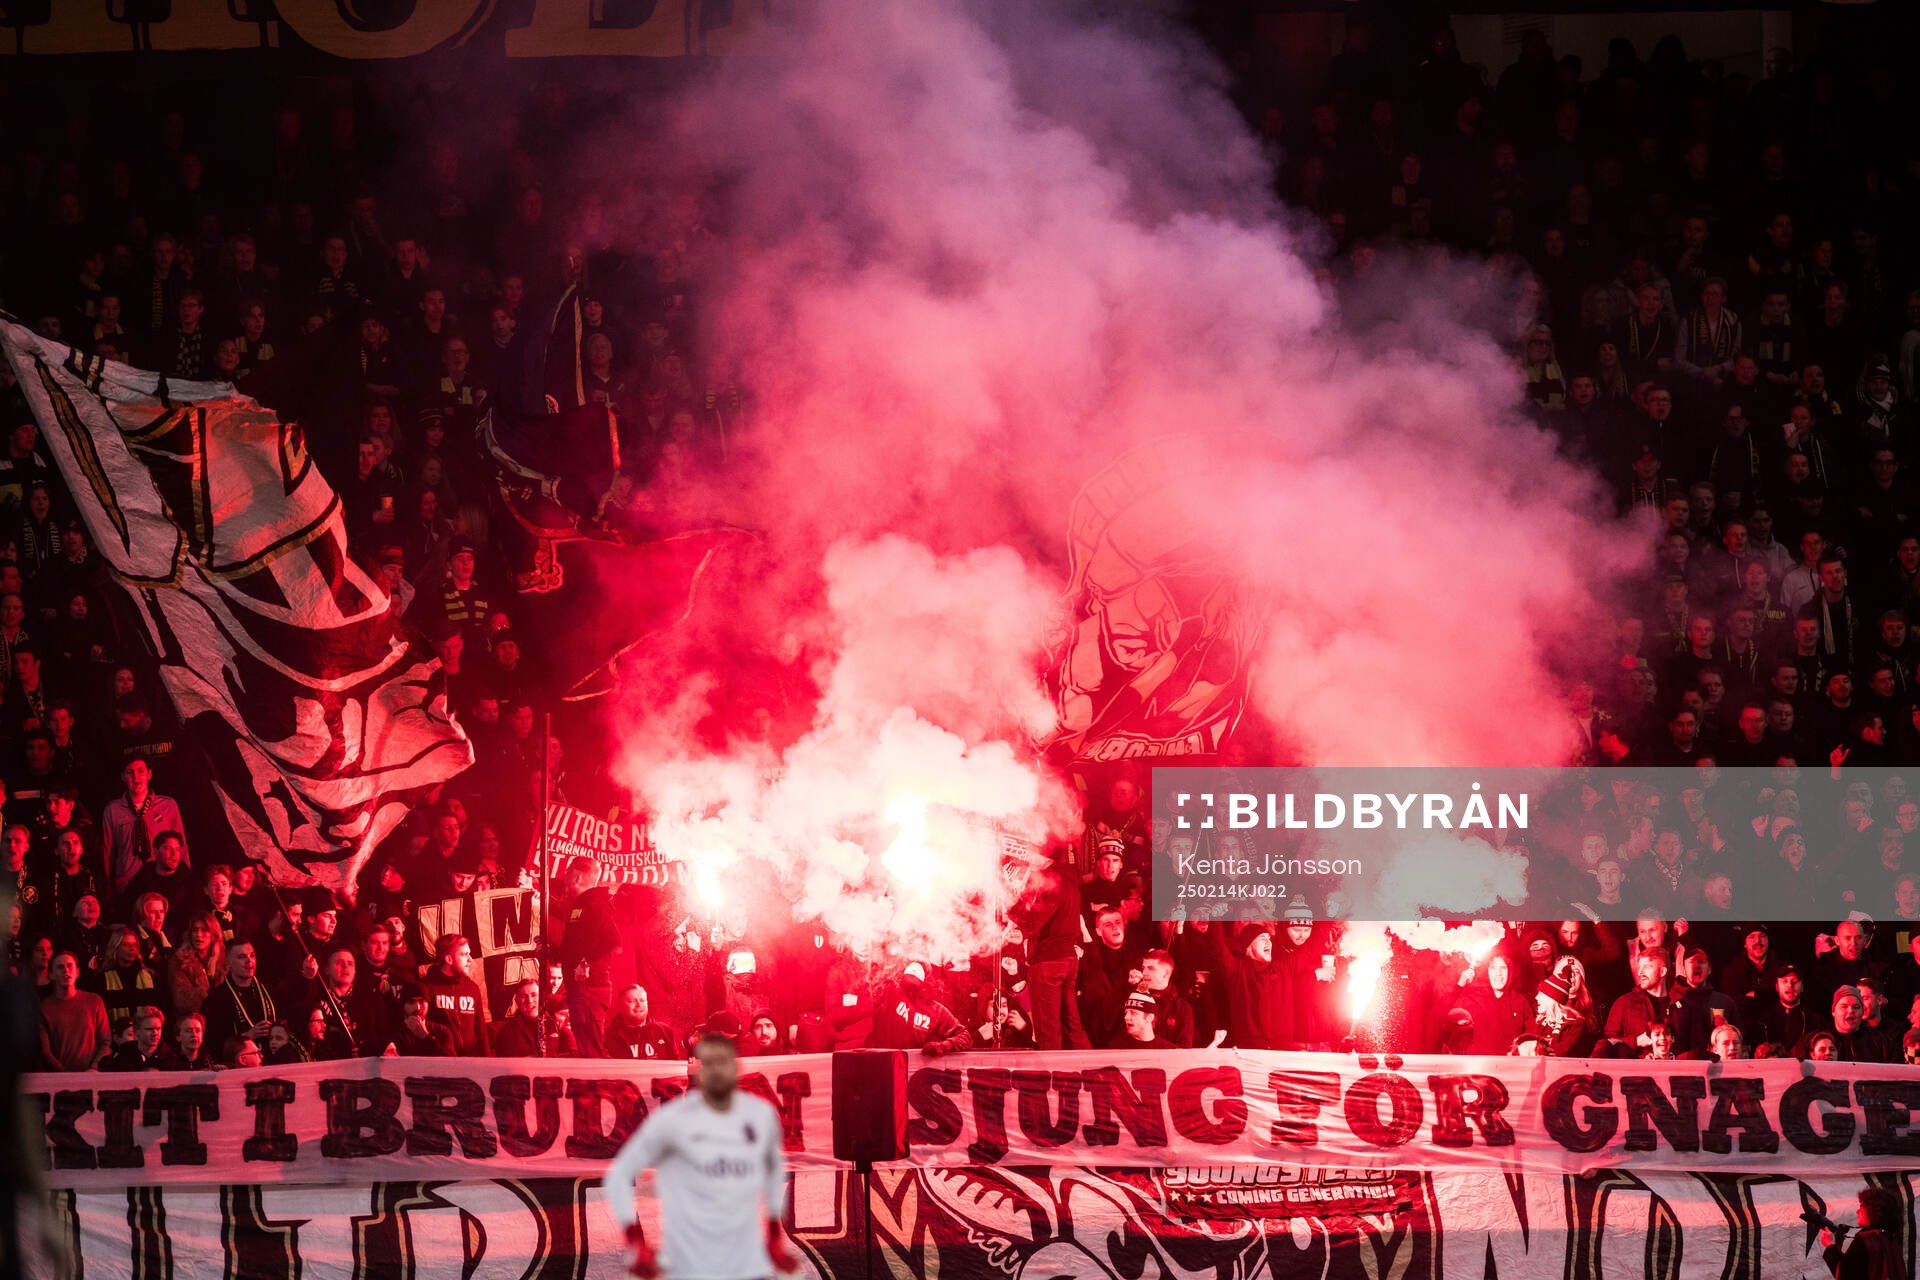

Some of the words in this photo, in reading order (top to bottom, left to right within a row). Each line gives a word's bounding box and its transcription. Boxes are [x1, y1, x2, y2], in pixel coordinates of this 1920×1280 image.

[548, 804, 623, 852] ULTRAS
[537, 837, 594, 859] LMÄNNA
[459, 996, 475, 1011] 02
[242, 1077, 299, 1162] I
[318, 1072, 812, 1160] BRUDN
[907, 1065, 1248, 1166] SJUNG
[1267, 1053, 1516, 1149] FÖR
[1215, 1189, 1284, 1206] COMING
